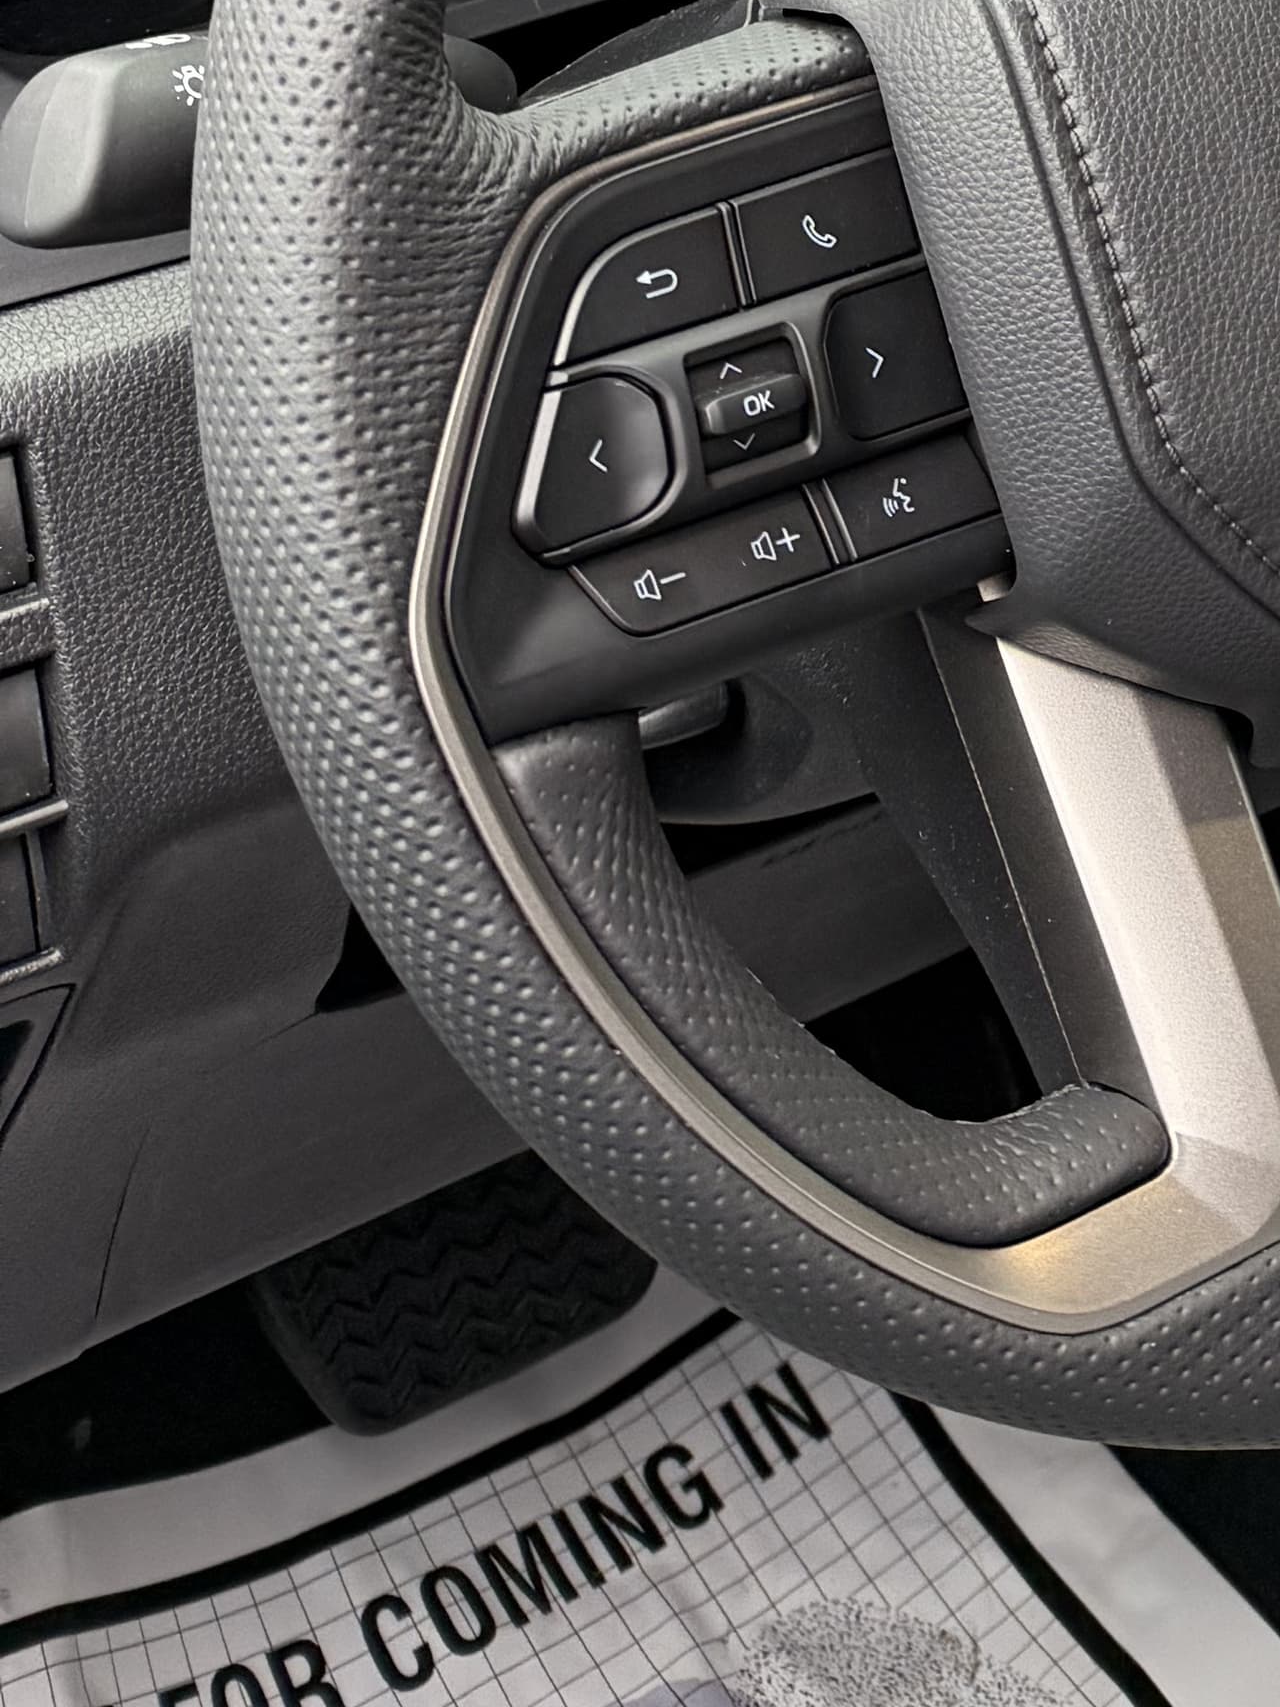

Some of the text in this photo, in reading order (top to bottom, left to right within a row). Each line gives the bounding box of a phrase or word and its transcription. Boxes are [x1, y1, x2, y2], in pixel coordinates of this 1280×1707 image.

[743, 391, 776, 416] OK
[361, 1443, 725, 1693] COMING
[719, 1361, 831, 1481] IN
